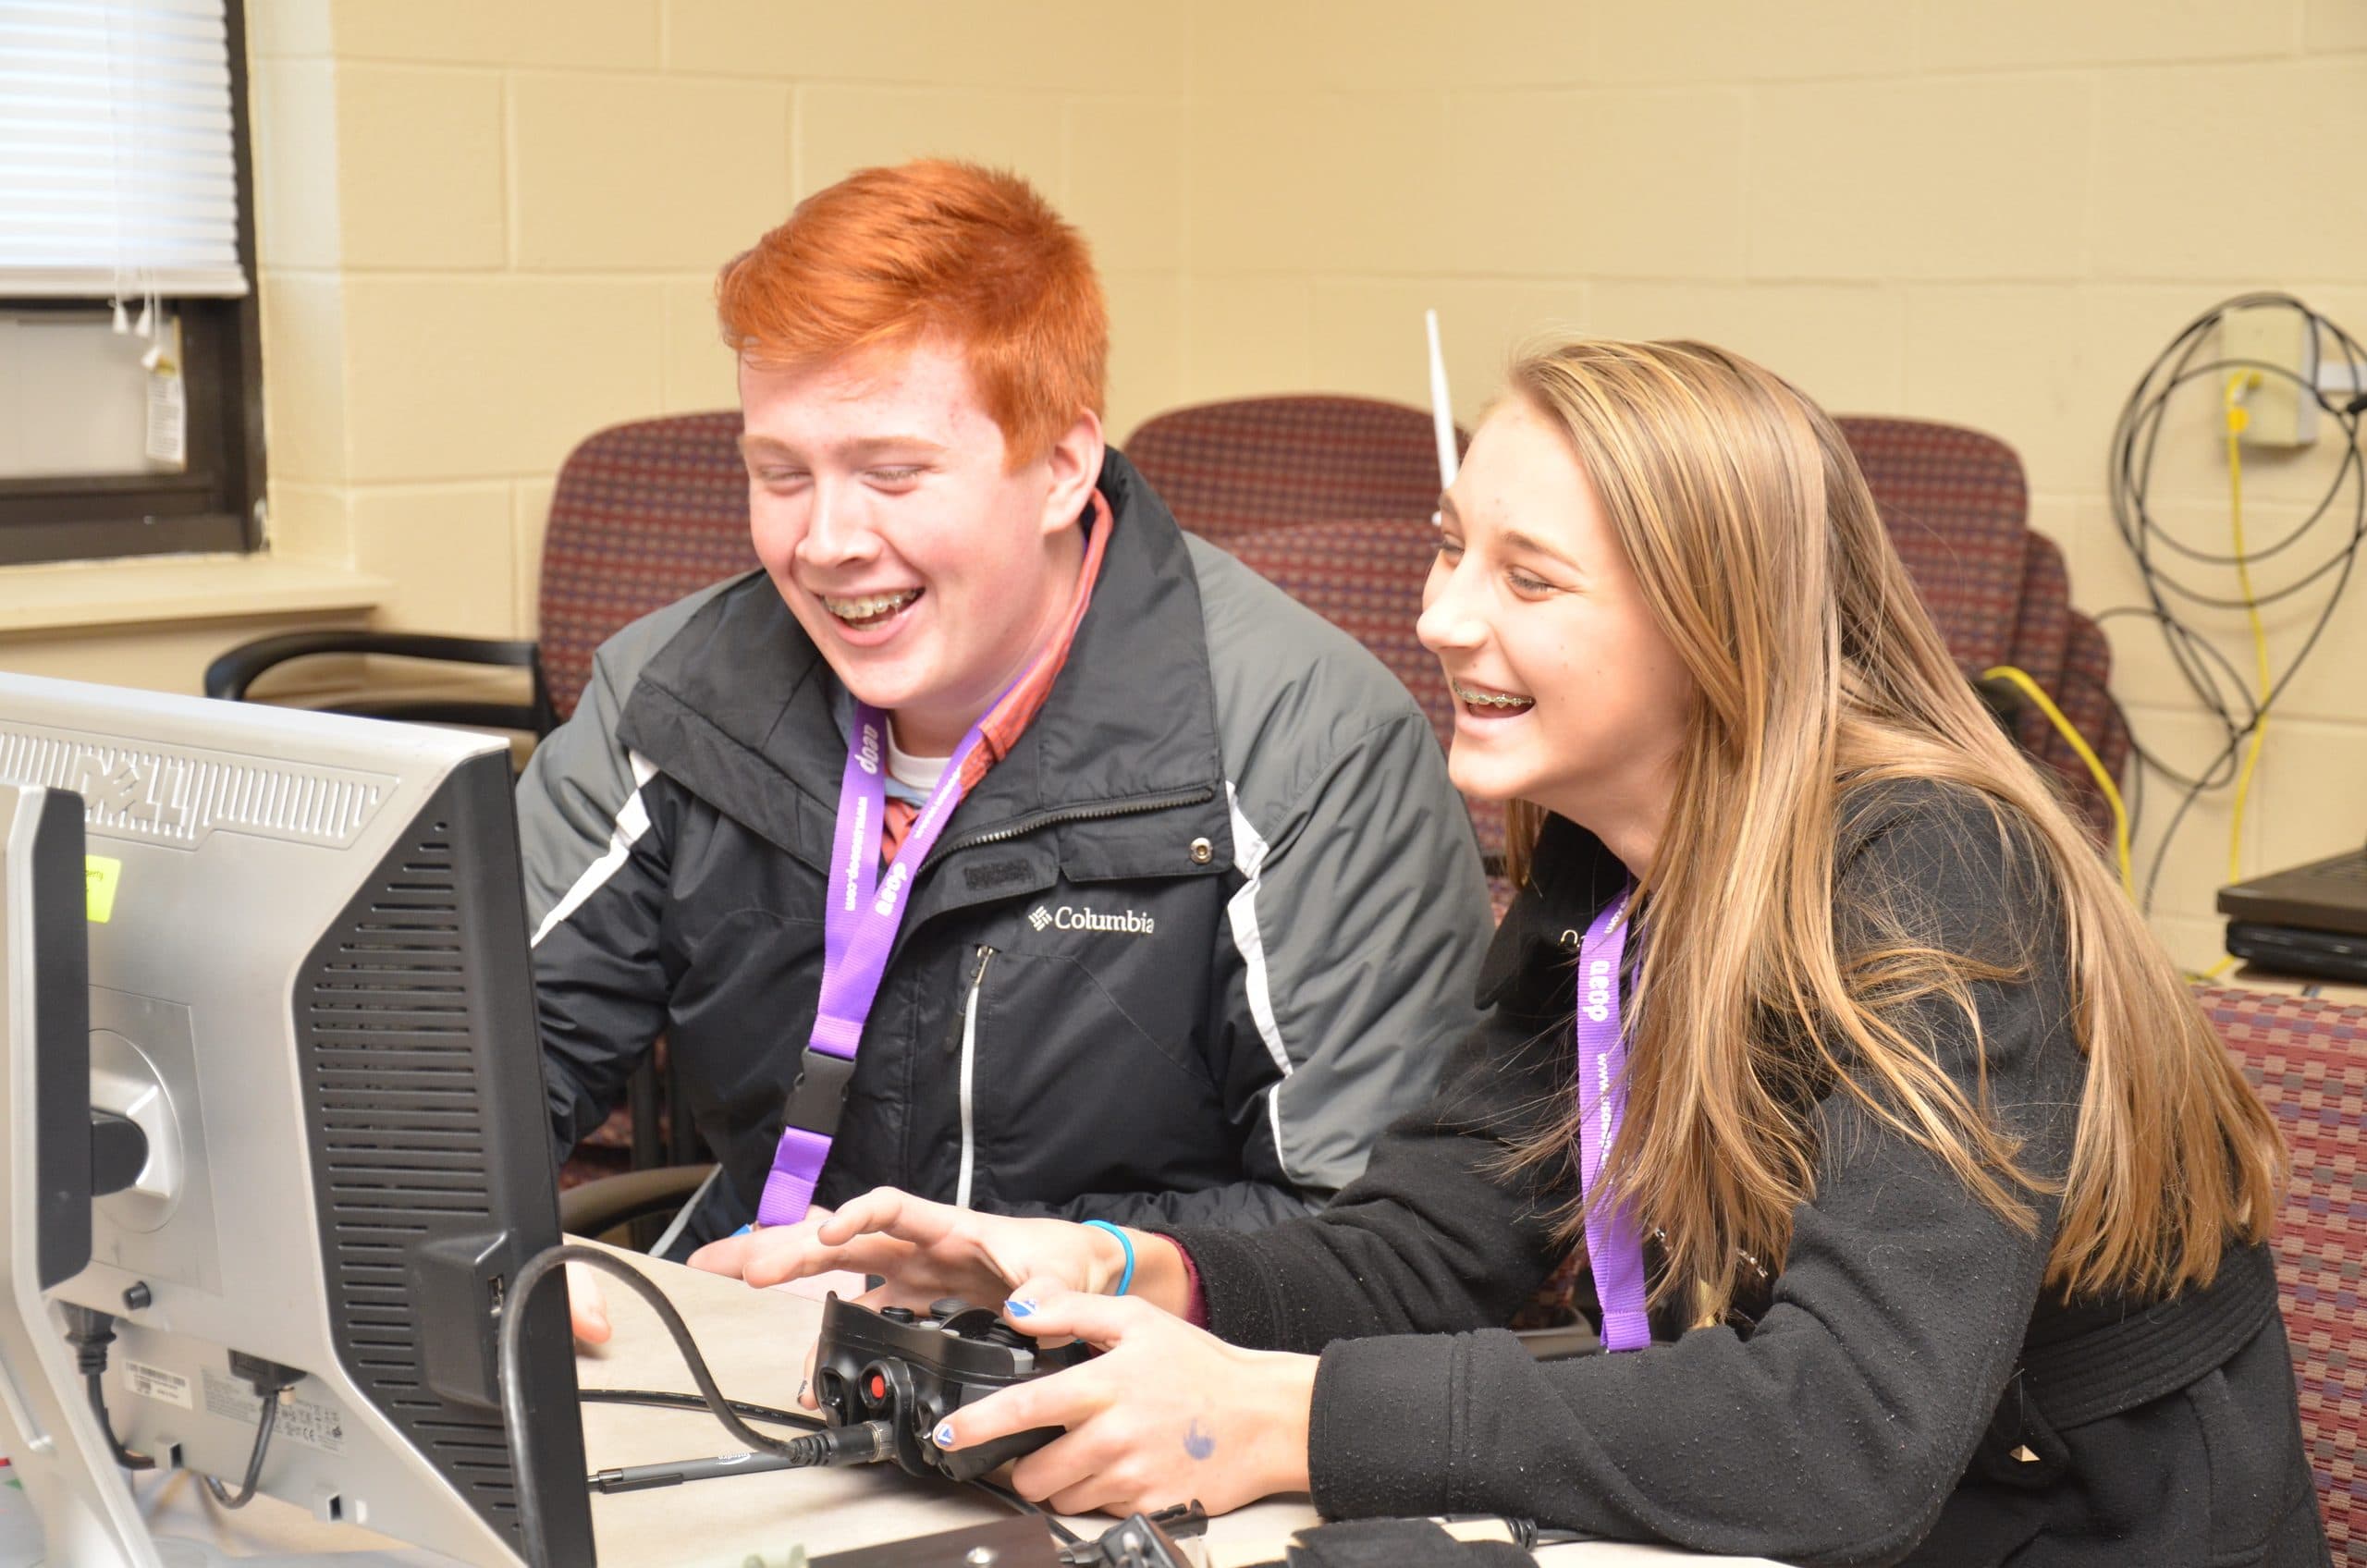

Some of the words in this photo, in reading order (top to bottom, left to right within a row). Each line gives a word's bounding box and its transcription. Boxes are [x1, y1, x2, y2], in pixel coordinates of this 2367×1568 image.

[853, 724, 878, 775] aeop
[1055, 906, 1155, 934] Columbia
[1582, 960, 1611, 1022] aeop
